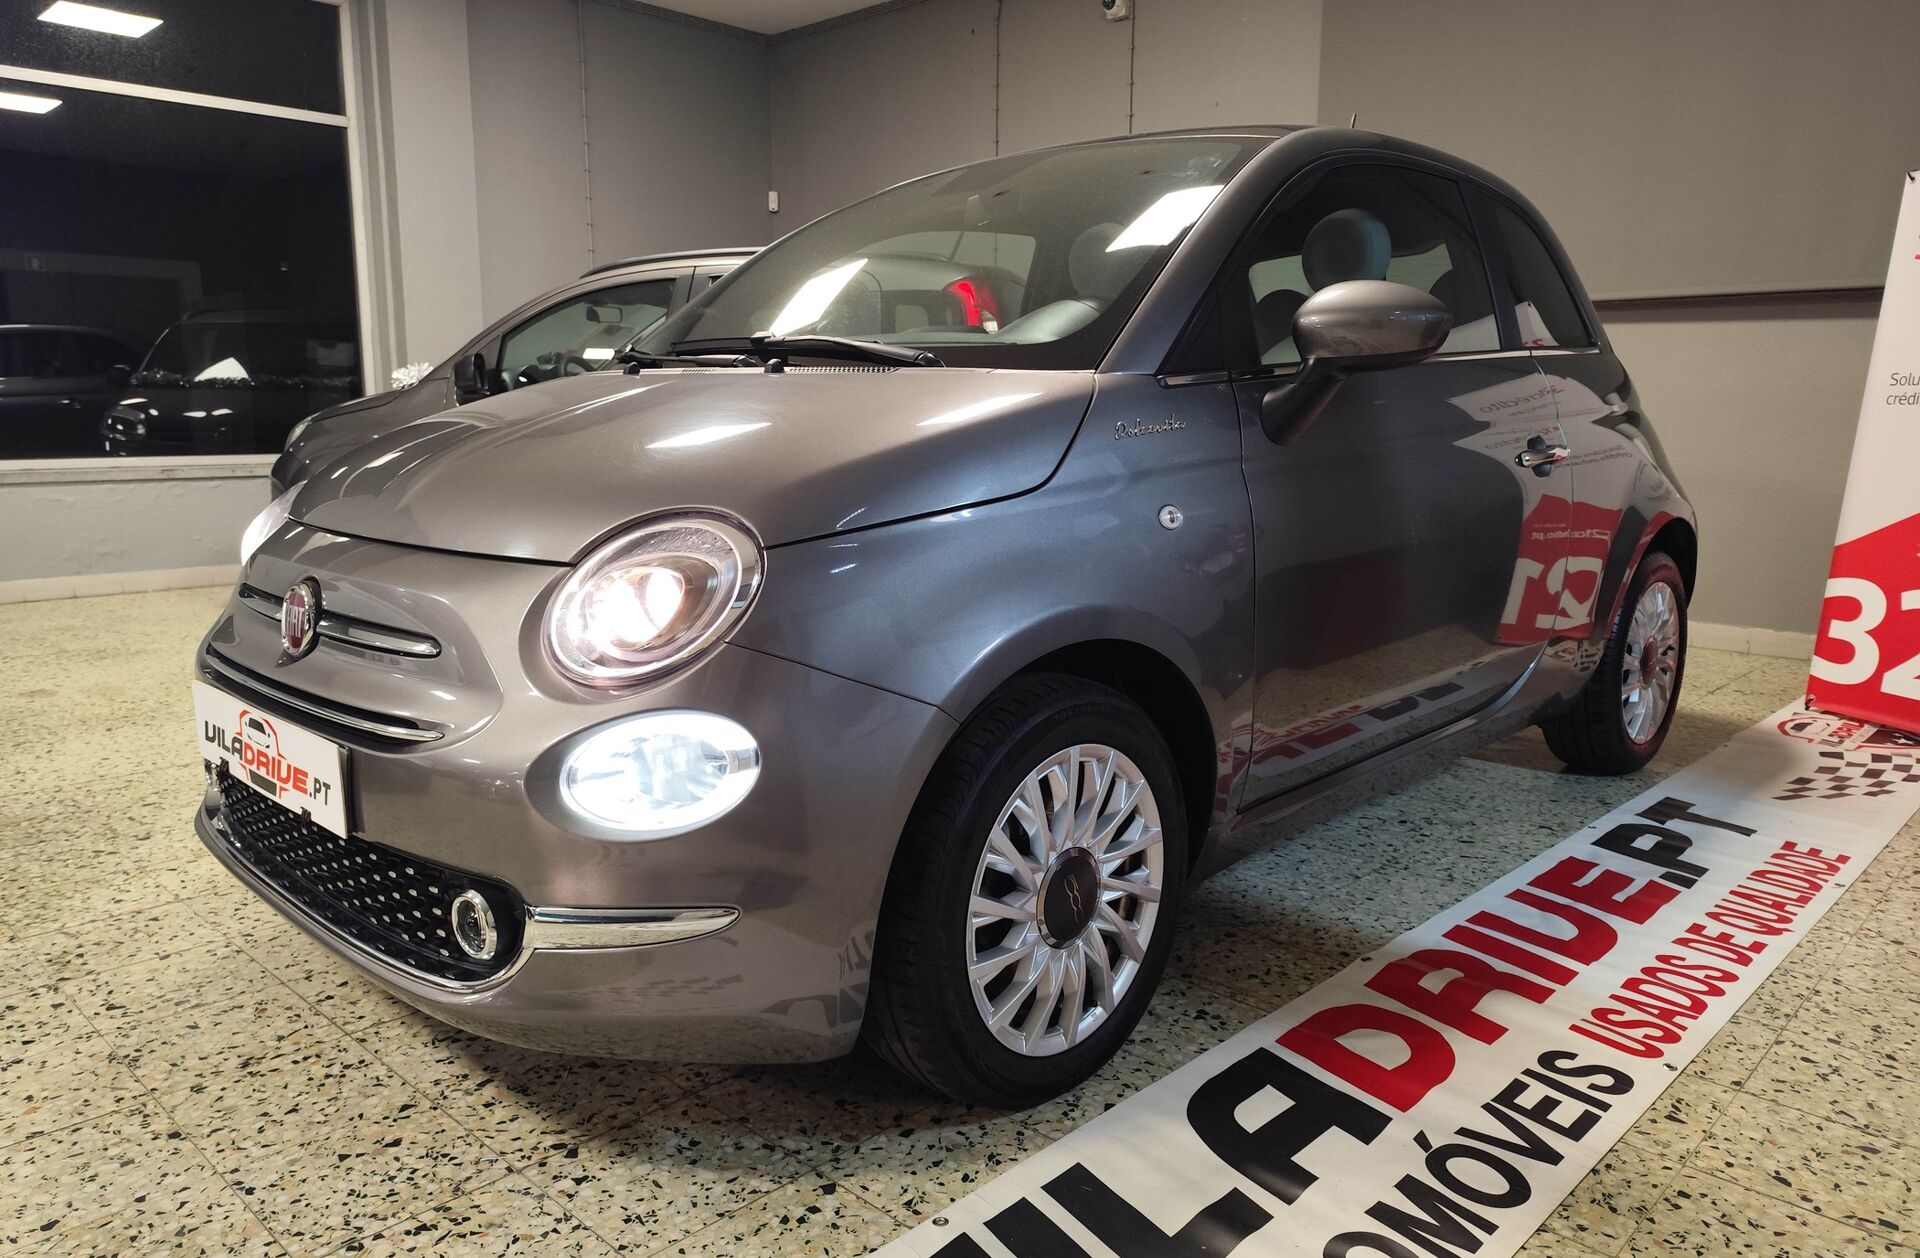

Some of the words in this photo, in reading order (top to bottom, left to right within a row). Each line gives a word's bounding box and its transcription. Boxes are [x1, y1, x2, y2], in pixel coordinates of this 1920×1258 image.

[1705, 840, 1852, 936] QUALIDADE
[1671, 922, 1769, 967] DE
[929, 796, 1758, 1258] LADRIVE.PT
[1569, 954, 1740, 1059] USADOS
